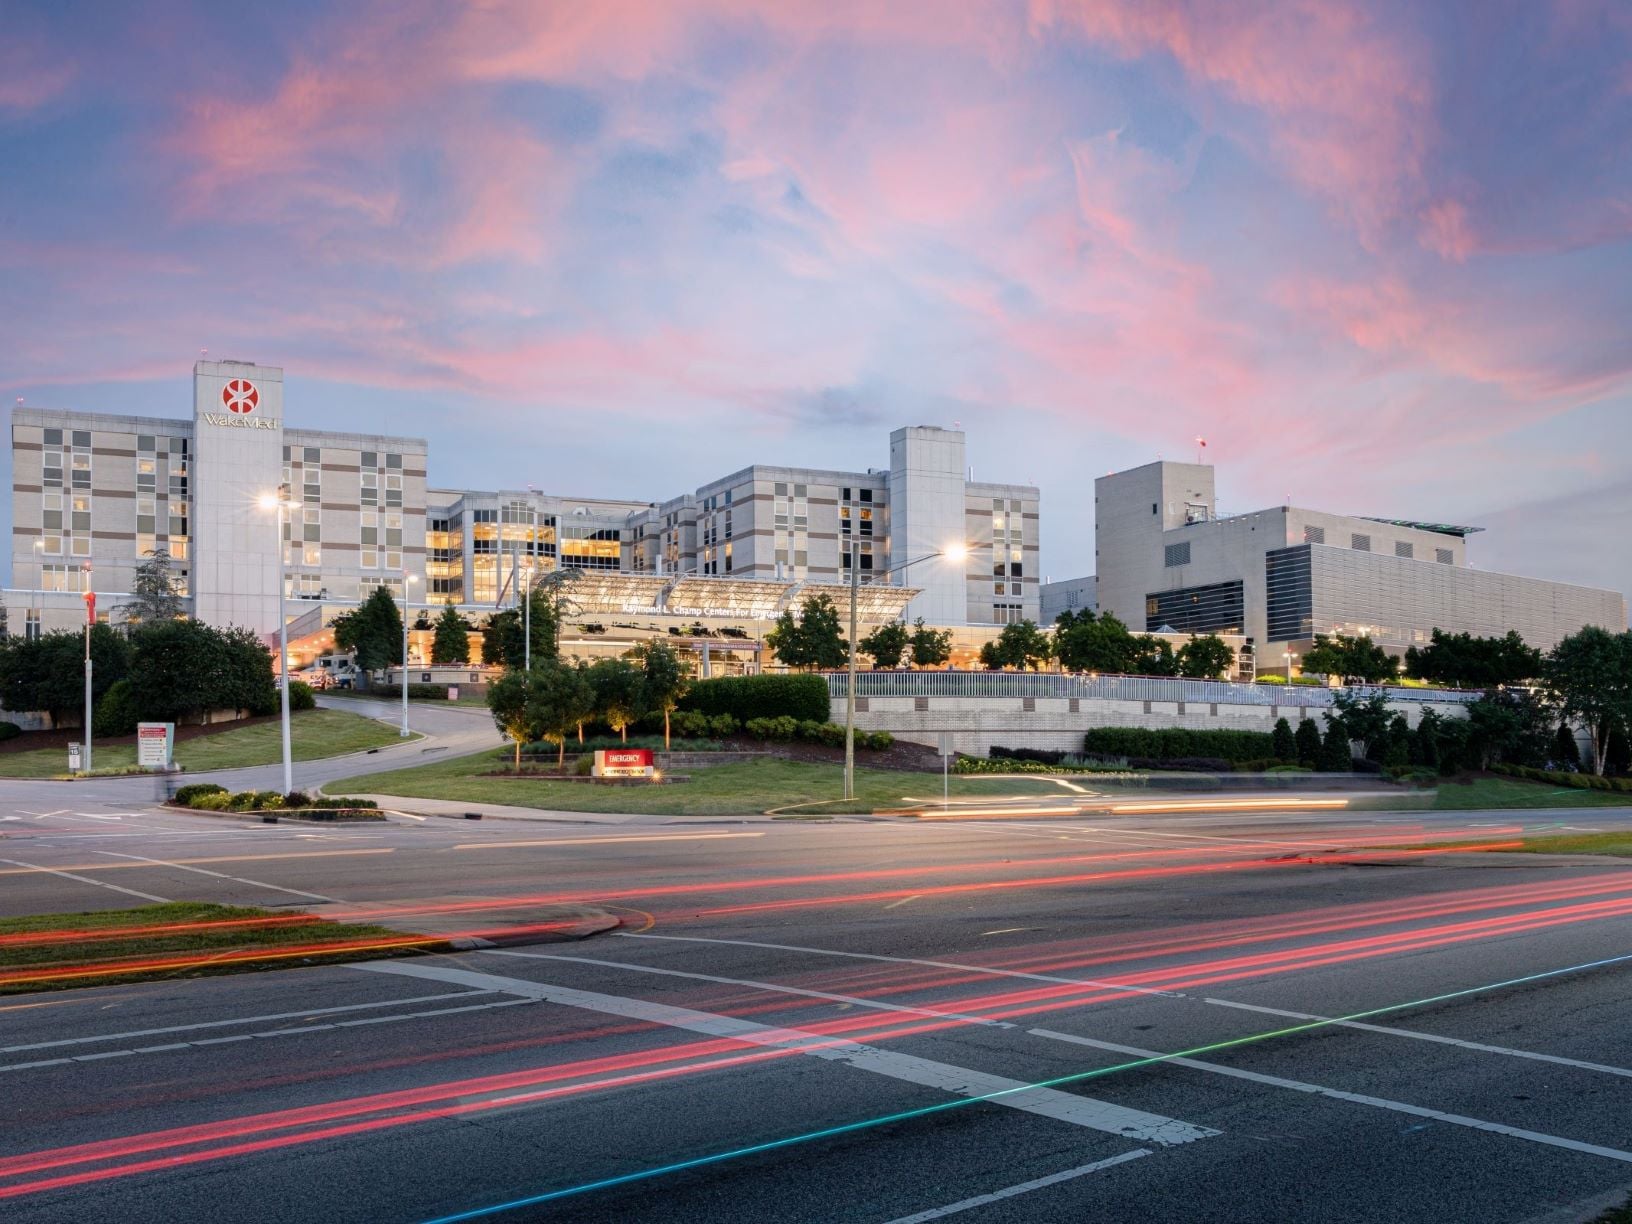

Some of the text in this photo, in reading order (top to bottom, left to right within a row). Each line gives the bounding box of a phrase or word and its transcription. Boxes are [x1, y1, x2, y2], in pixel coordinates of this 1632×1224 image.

[204, 412, 278, 430] WakeMed
[673, 605, 702, 616] Champ
[609, 754, 640, 762] EMERGENCY
